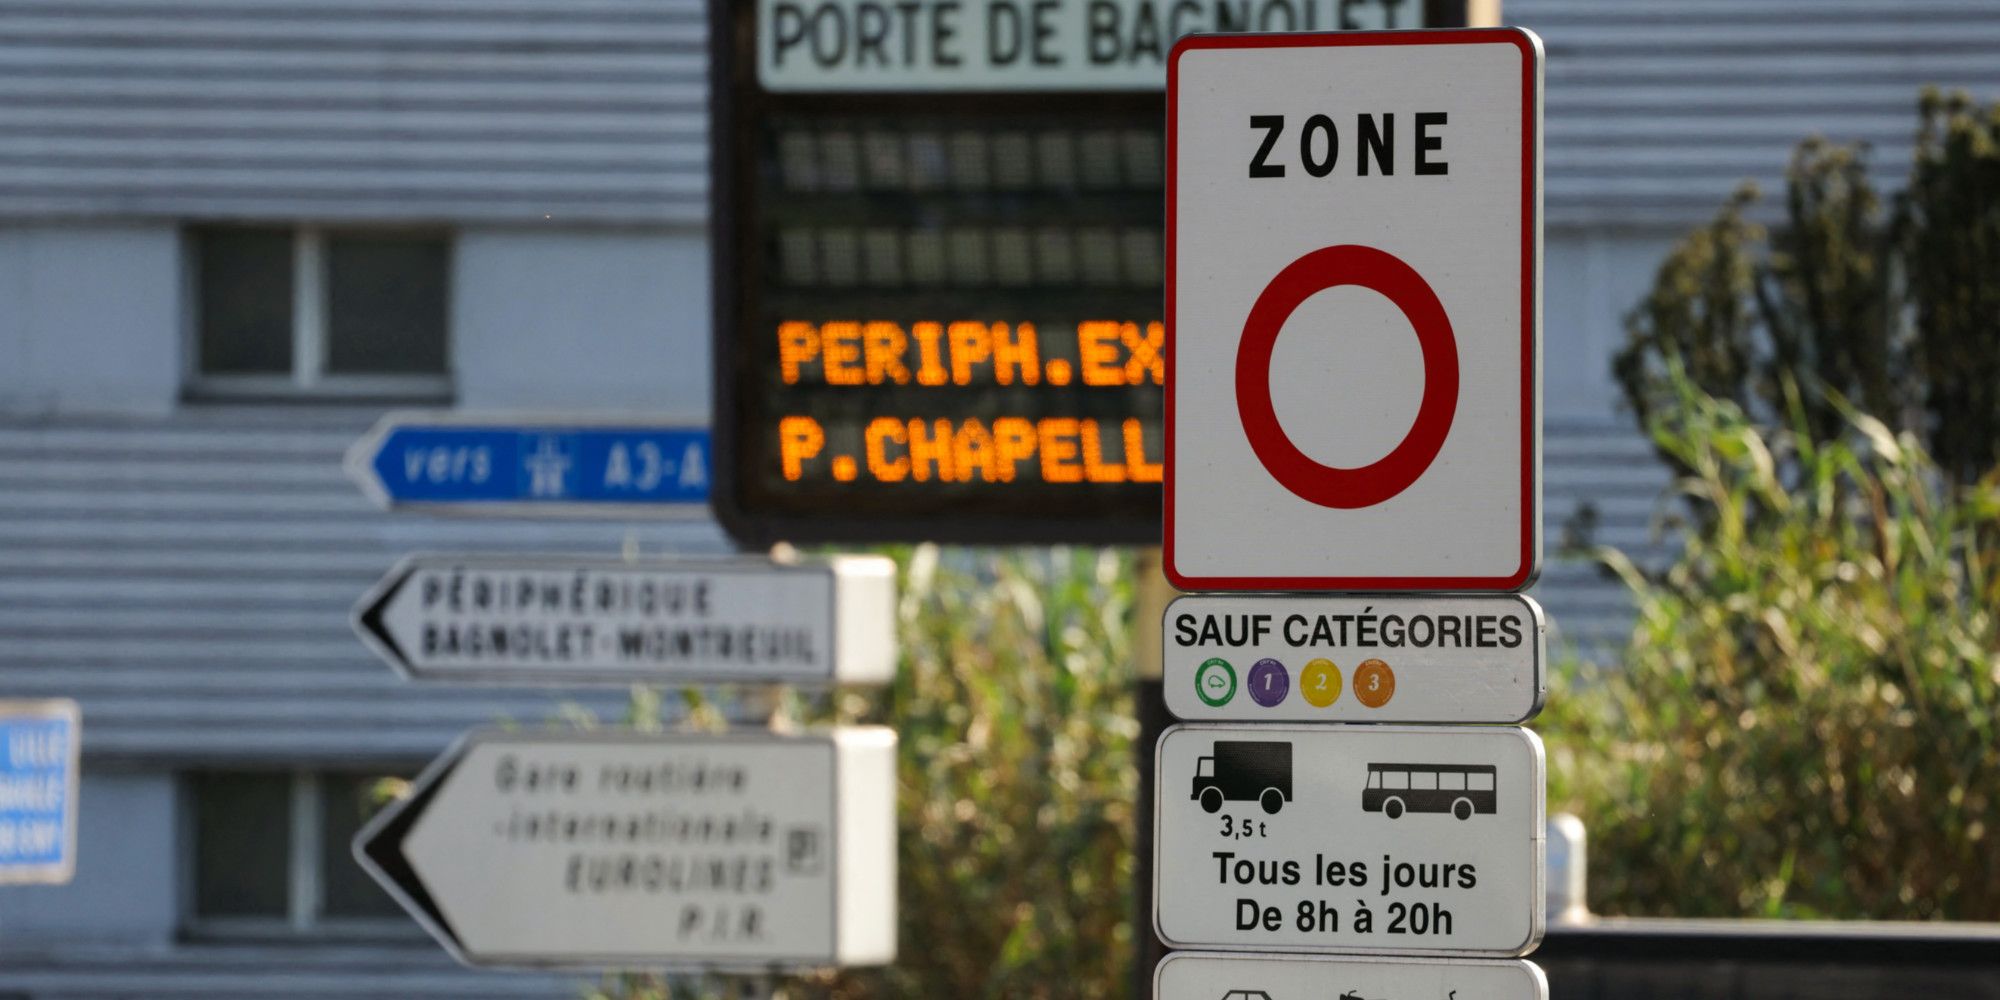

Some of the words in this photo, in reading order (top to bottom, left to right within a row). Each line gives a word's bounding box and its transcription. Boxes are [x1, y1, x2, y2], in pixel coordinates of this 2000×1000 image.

[771, 3, 962, 69] PORTE
[987, 2, 1062, 67] DE
[1249, 112, 1448, 178] ZONE
[404, 445, 491, 484] vers
[421, 567, 715, 615] PÉRIPHÉRIQUE
[1175, 614, 1271, 647] SAUF
[1283, 607, 1522, 648] CATÉGORIES
[1264, 672, 1273, 691] 1
[1315, 672, 1328, 691] 2
[1368, 673, 1380, 691] 3
[1220, 814, 1253, 840] 3,5
[1259, 822, 1267, 838] t
[1213, 852, 1300, 885] Tous
[1316, 854, 1367, 887] les
[1381, 855, 1476, 896] jours
[1236, 899, 1282, 931] De
[1296, 900, 1338, 932] 8h
[1354, 900, 1373, 933] à
[1387, 902, 1452, 935] 20h
